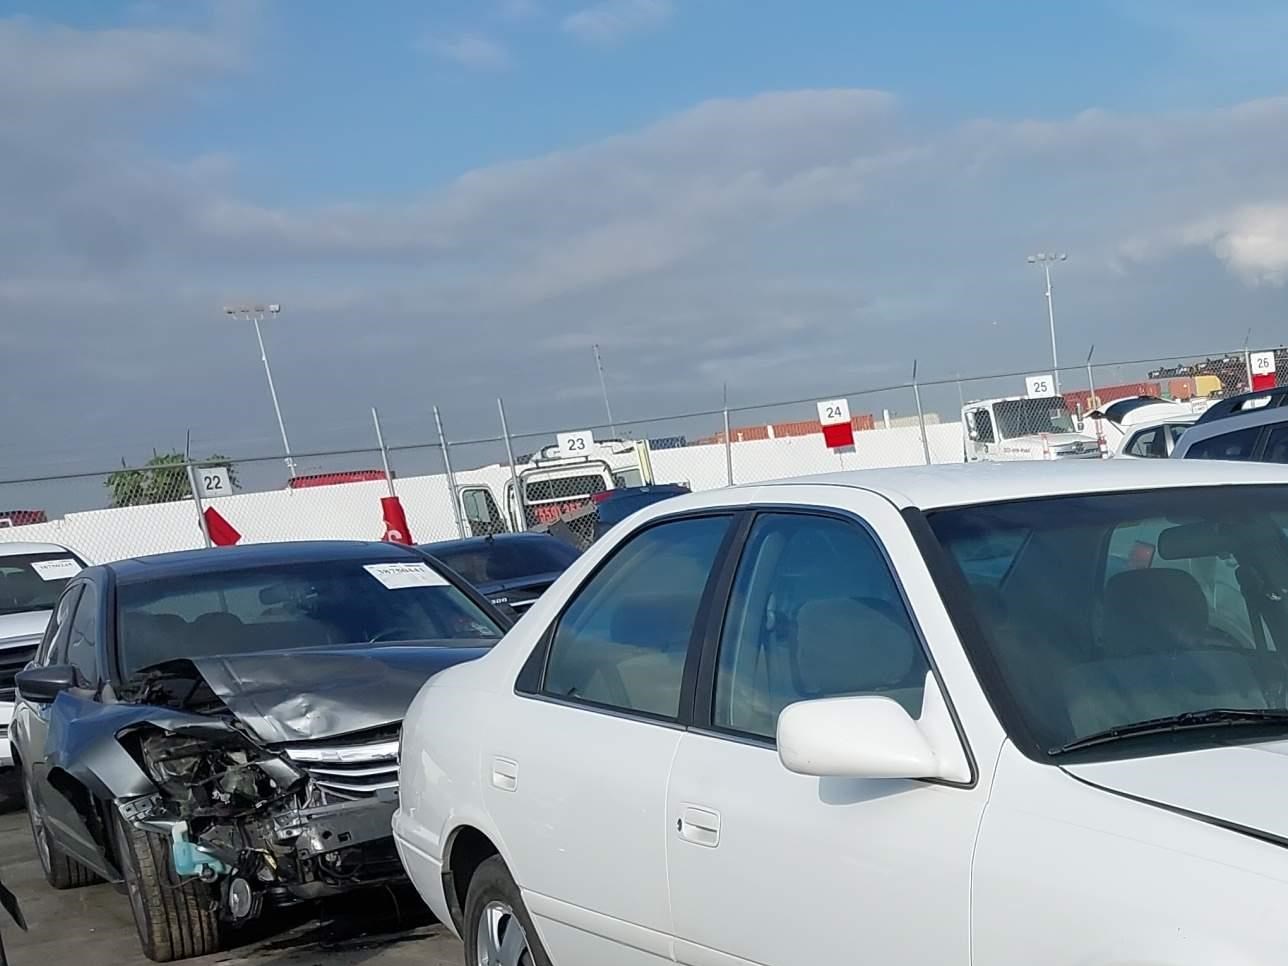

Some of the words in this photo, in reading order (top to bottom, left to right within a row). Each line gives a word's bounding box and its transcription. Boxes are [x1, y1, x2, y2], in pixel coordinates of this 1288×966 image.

[1257, 357, 1270, 369] 26
[1033, 381, 1048, 393] 25
[826, 405, 842, 419] 24
[567, 437, 586, 451] 23
[204, 475, 223, 490] 22
